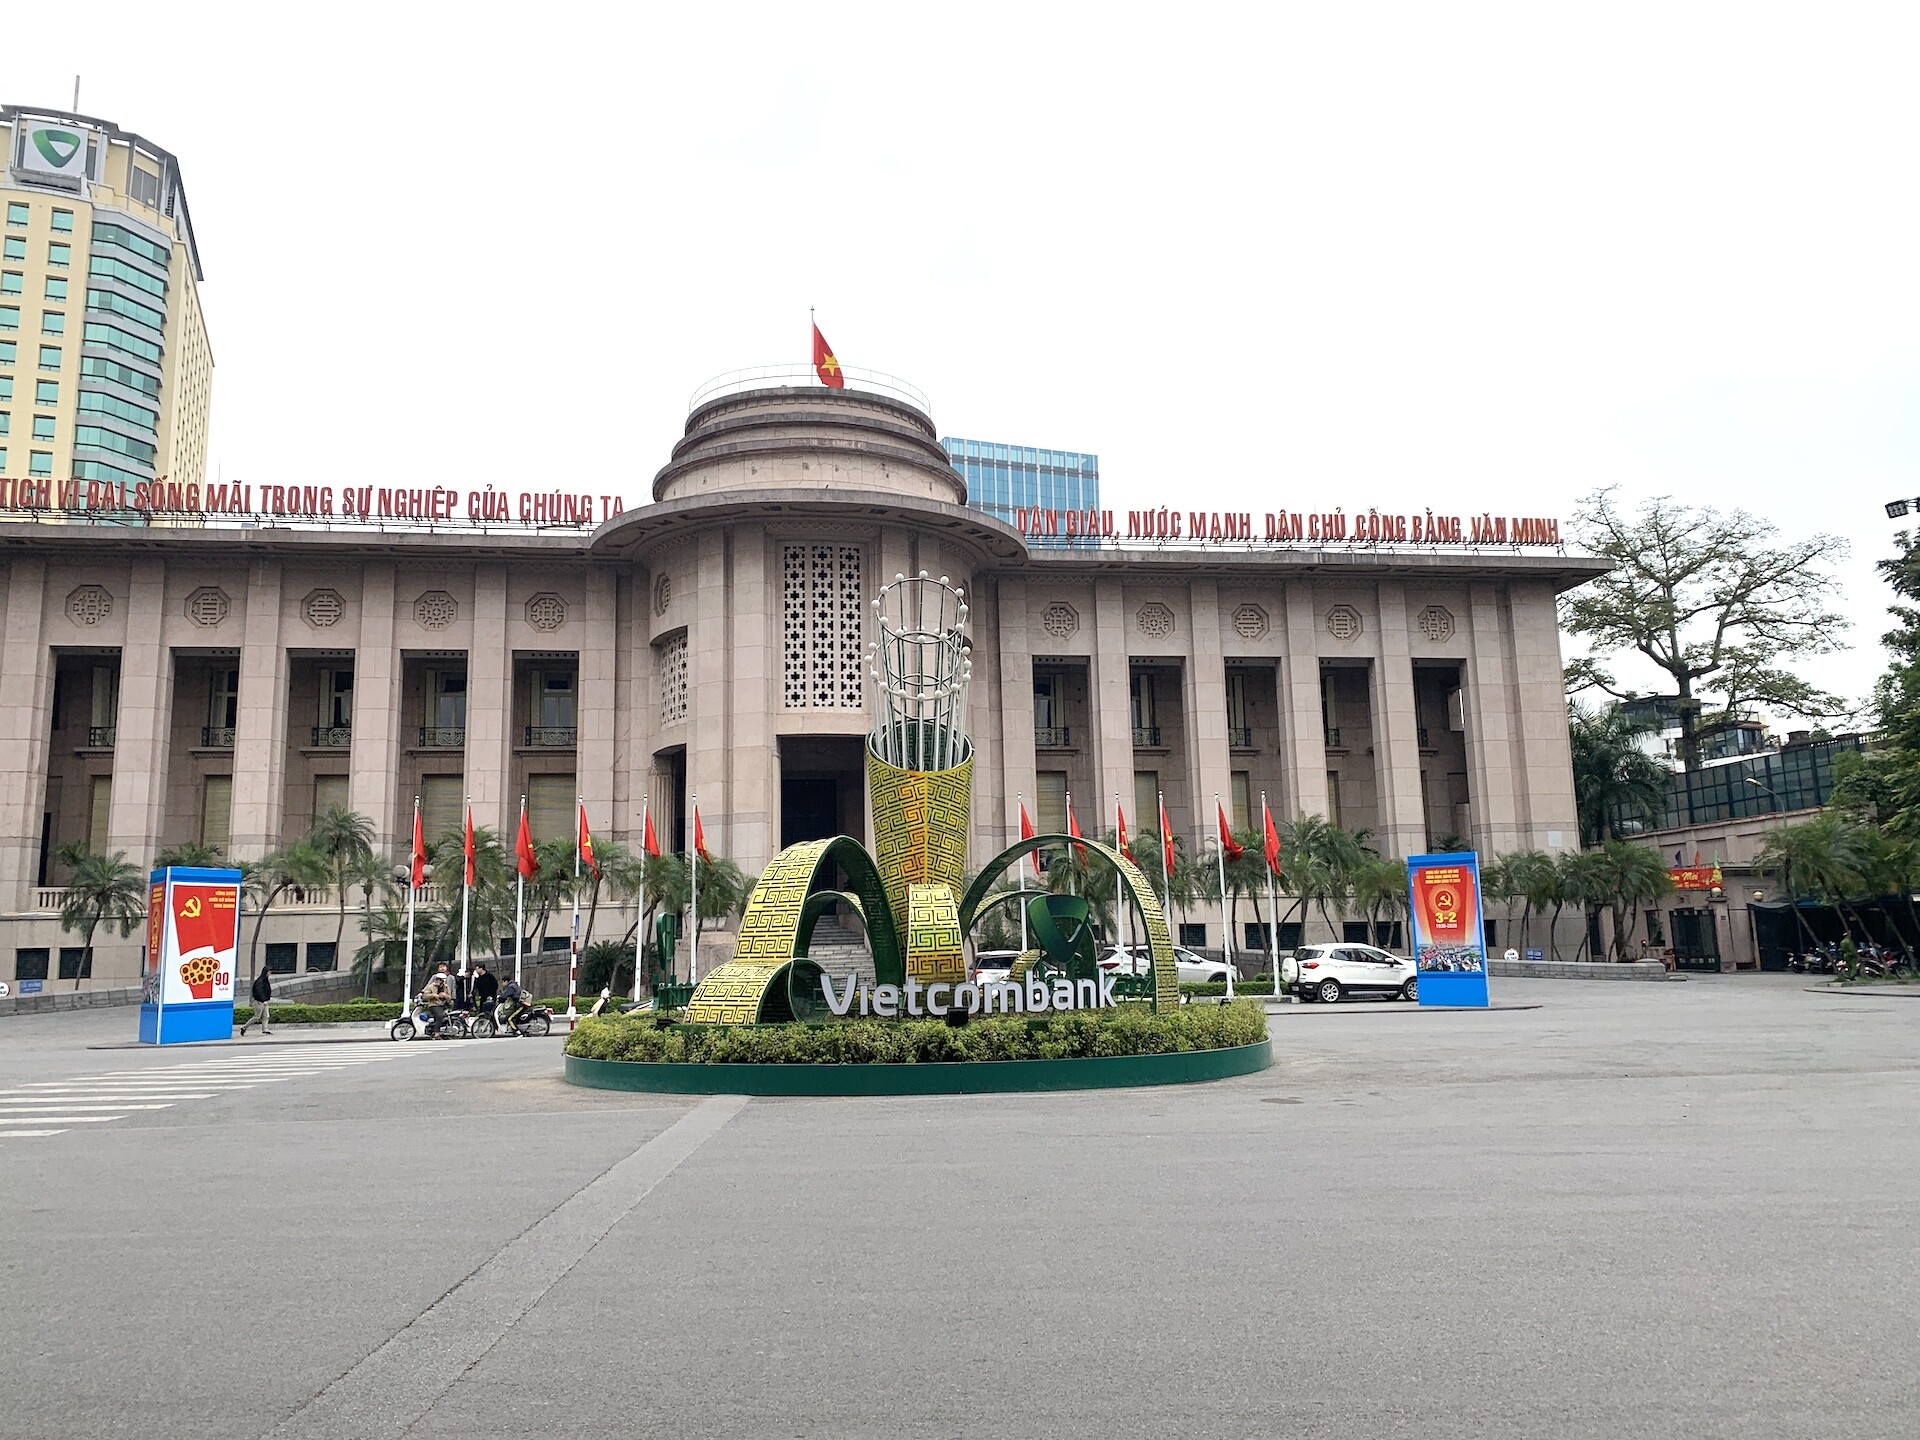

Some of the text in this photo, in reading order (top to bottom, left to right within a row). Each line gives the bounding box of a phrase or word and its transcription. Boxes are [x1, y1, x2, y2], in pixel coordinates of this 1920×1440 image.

[86, 480, 126, 513] ĐẠI
[133, 475, 200, 513] SỐNG
[205, 480, 251, 513] MÃI
[260, 485, 333, 516] TRONG
[342, 485, 373, 521] SỰ
[377, 485, 458, 523] NGHIỆP
[467, 484, 510, 521] CỦA
[519, 489, 592, 524] CHÚNG
[600, 495, 624, 521] TA
[1016, 505, 1058, 536] DÂN
[1128, 505, 1181, 538] NƯỚC
[1189, 512, 1257, 543] MẠNH,
[1265, 509, 1303, 540] DÂN
[1471, 513, 1506, 543] VĂN
[1435, 911, 1457, 924] 3-2
[214, 972, 229, 986] 90
[820, 967, 1118, 1016] Vietcombank
